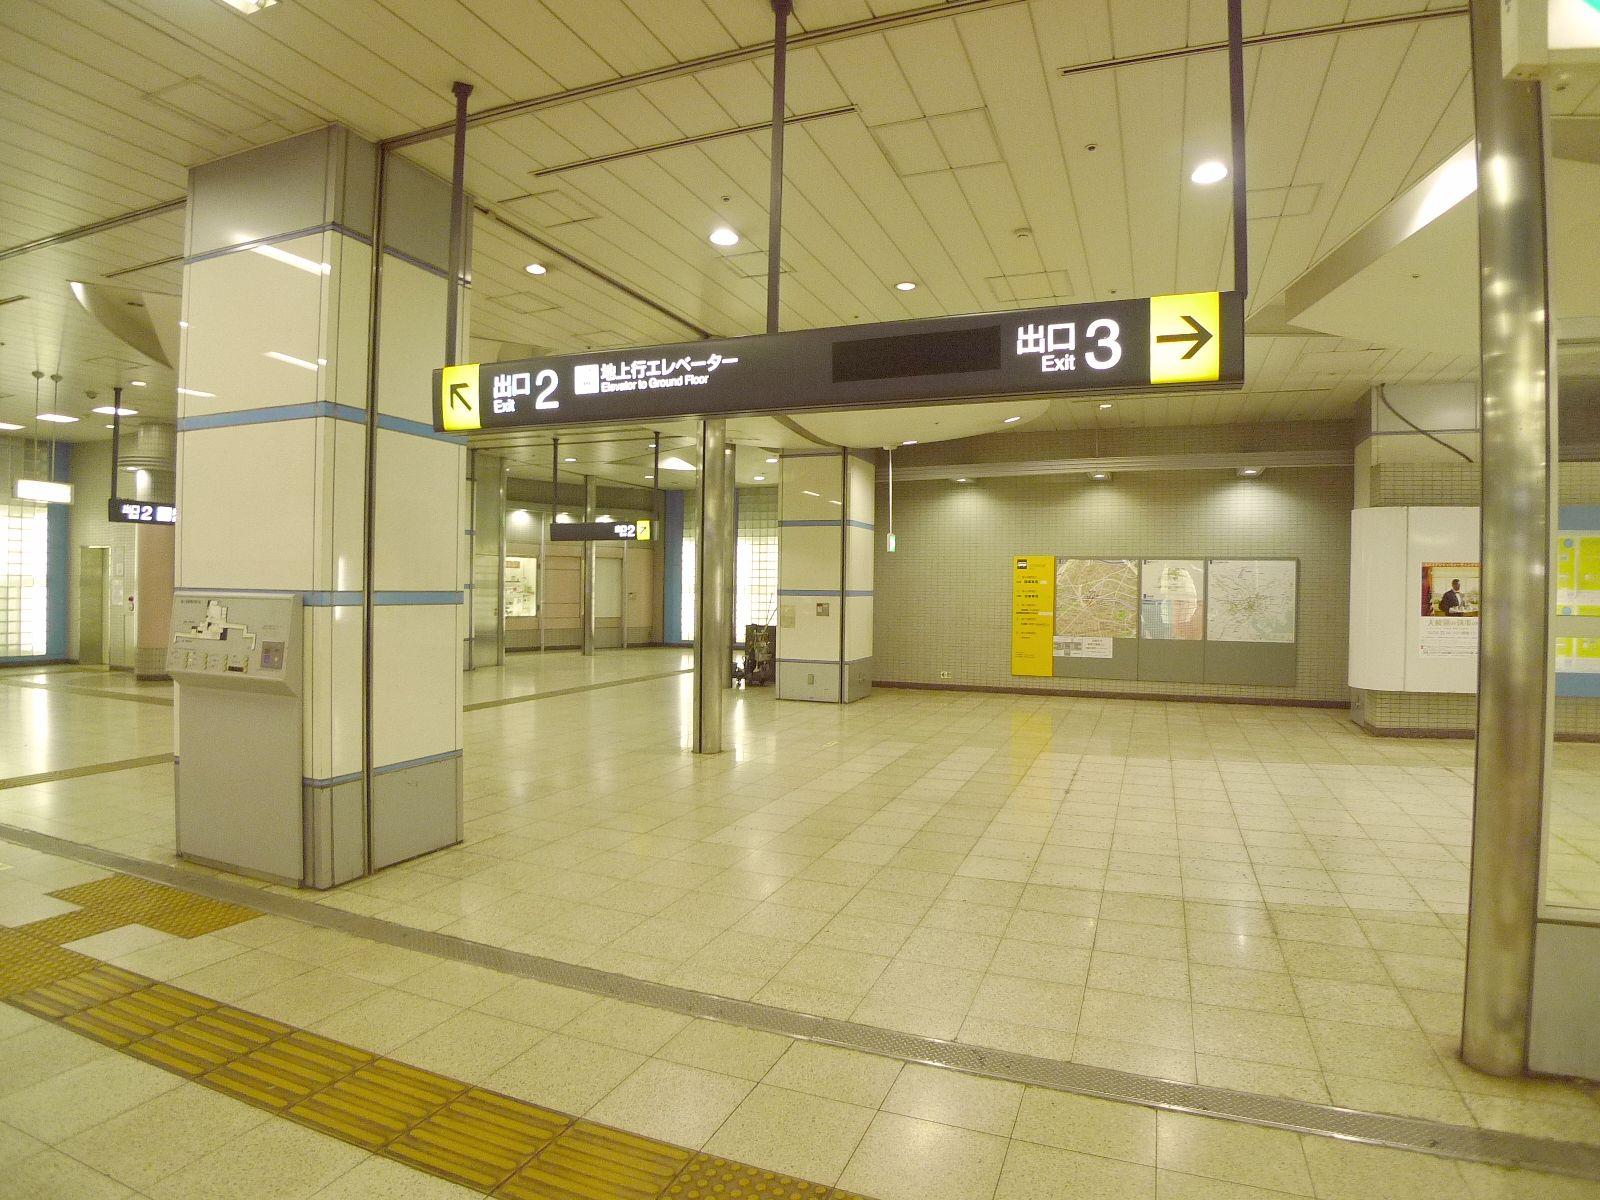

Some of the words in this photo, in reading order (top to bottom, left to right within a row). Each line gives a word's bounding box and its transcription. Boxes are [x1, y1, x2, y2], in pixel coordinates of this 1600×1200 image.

[1017, 322, 1076, 355] 出口
[1084, 318, 1122, 370] 3
[600, 353, 739, 381] 地上行エレベーター
[1041, 353, 1076, 372] Exit
[493, 372, 531, 399] 出口
[535, 369, 560, 410] 2
[601, 381, 638, 393] Elevator
[638, 379, 648, 390] to
[648, 376, 684, 389] Ground
[684, 374, 710, 386] Floor
[493, 399, 516, 414] Exit
[140, 505, 153, 521] 2
[627, 525, 635, 537] 2
